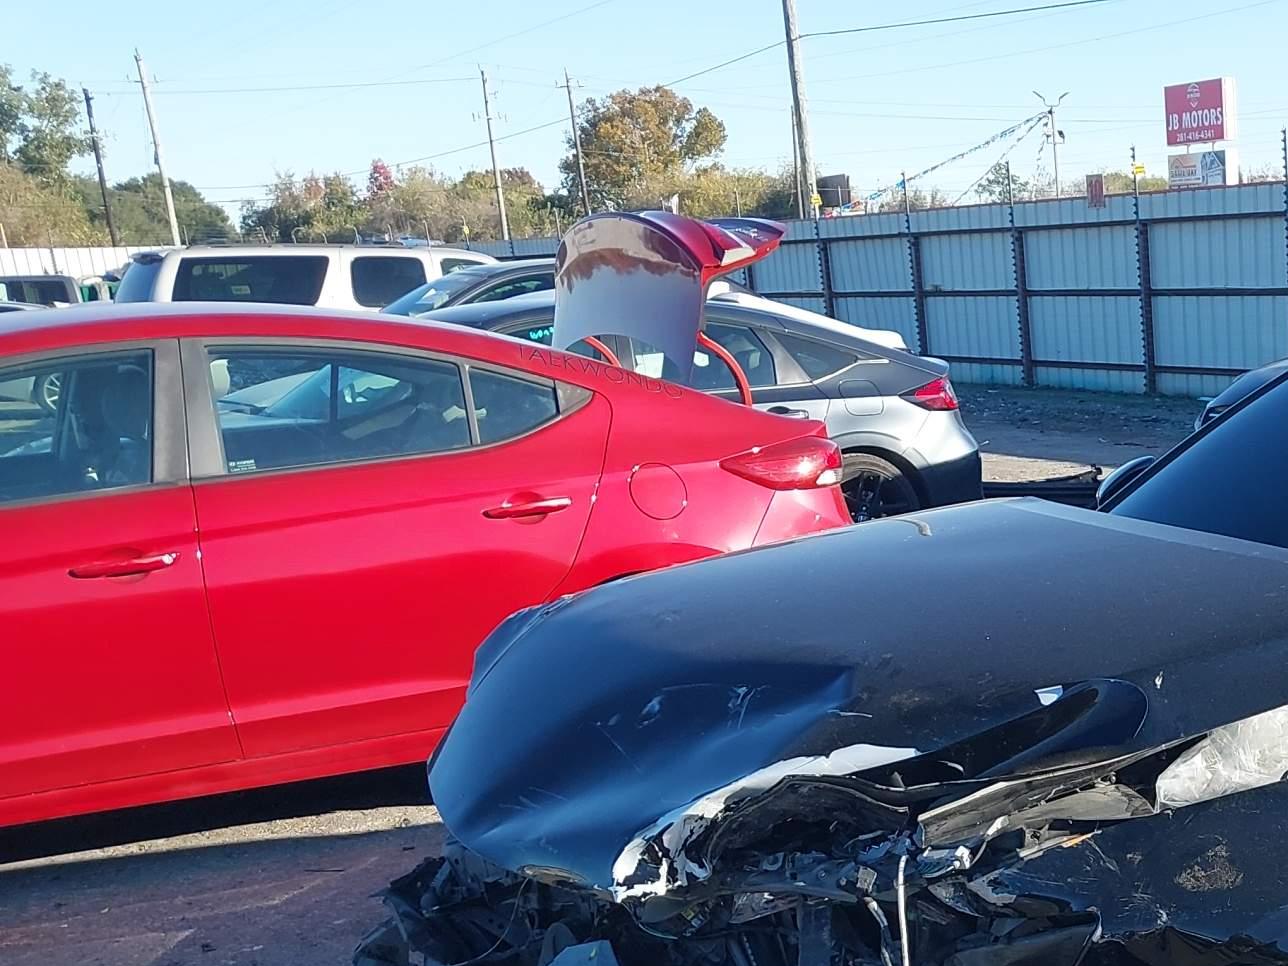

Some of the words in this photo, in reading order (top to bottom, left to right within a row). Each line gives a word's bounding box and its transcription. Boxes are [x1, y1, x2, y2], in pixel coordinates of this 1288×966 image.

[1168, 113, 1179, 131] JB
[1182, 107, 1222, 129] MOTORS
[516, 344, 683, 399] TAEKWONDO
